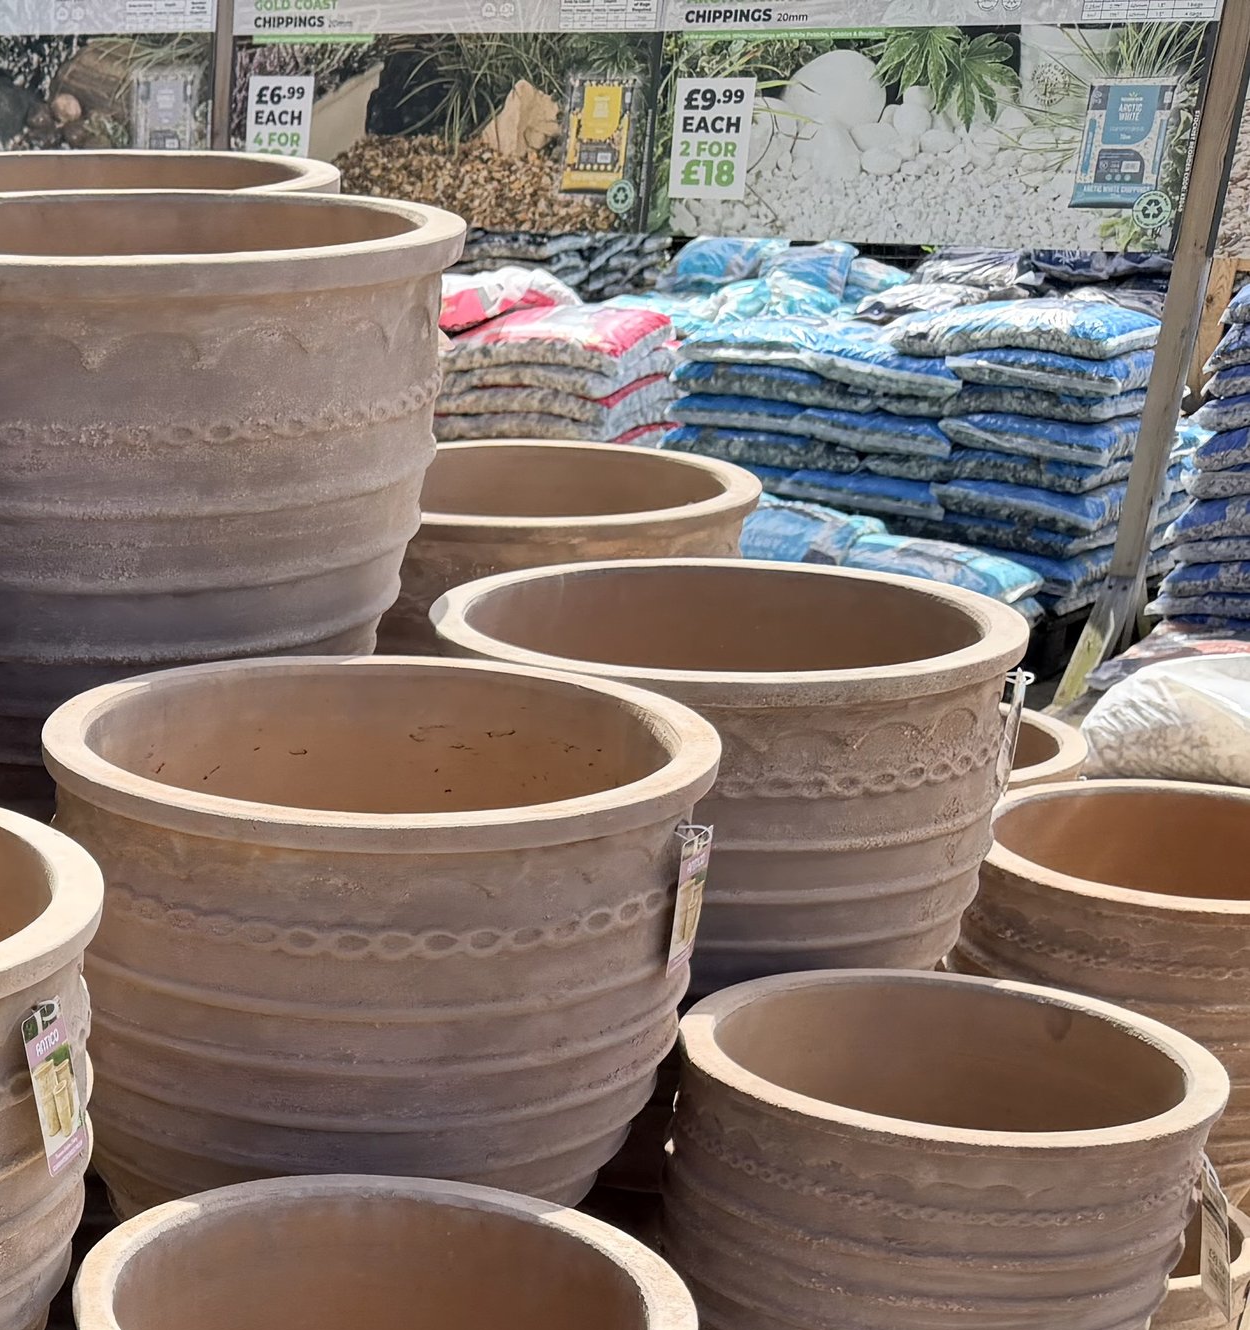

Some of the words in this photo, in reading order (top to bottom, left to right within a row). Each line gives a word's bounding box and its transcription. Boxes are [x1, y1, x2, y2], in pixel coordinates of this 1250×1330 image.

[254, 0, 291, 11] GOLD
[294, 0, 338, 10] COAST
[254, 16, 325, 28] CHIPPINGS
[684, 8, 772, 24] CHIPPINGS
[776, 11, 808, 23] 20mm
[255, 86, 305, 105] £6.99
[684, 88, 745, 111] £9.99
[1119, 103, 1142, 112] ARCTIC
[254, 110, 302, 126] EACH
[682, 116, 741, 133] EACH
[1119, 112, 1140, 121] WHITE
[253, 132, 263, 146] 4
[267, 132, 300, 148] FOR
[679, 141, 691, 157] 2
[696, 141, 737, 157] FOR
[681, 160, 735, 187] £18
[35, 1028, 60, 1057] ANTICO
